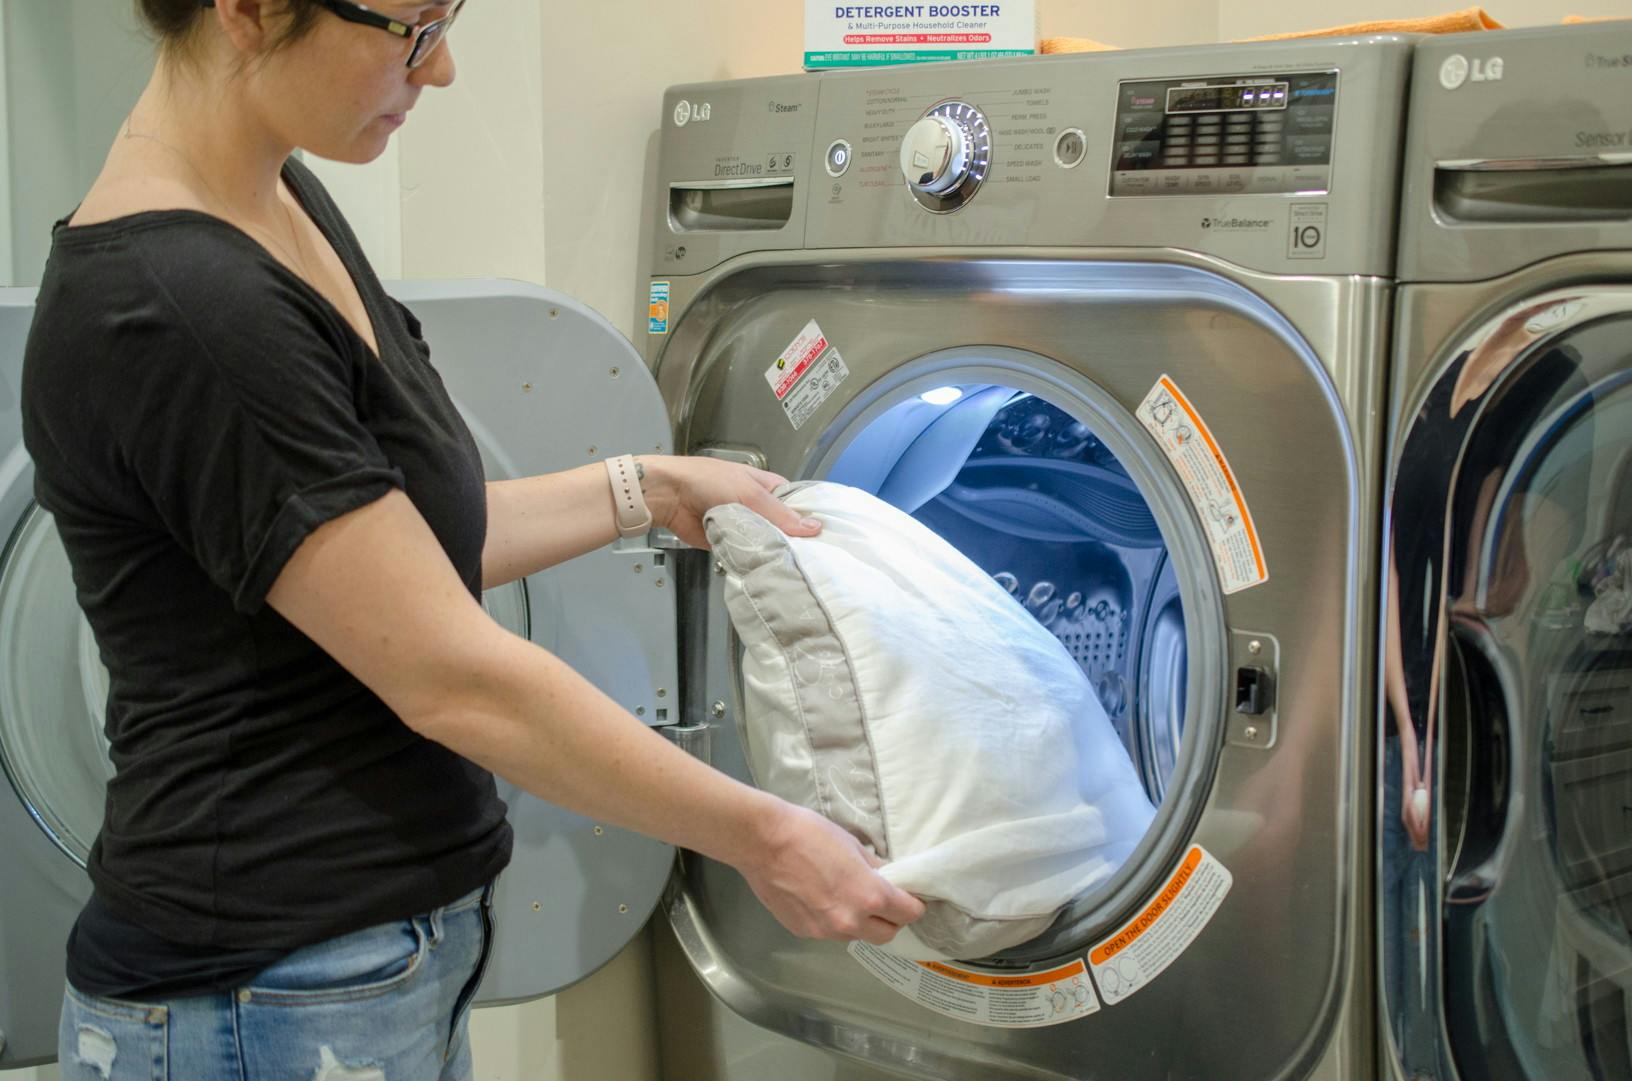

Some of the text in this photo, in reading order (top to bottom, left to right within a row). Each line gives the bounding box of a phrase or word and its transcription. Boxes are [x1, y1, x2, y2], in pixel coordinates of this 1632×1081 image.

[835, 5, 1000, 19] DETERGENT BOOSTER
[855, 22, 911, 31] Multi-Purpose
[912, 21, 955, 29] Household
[956, 21, 987, 29] Cleaner
[844, 36, 865, 44] Helps
[895, 35, 918, 43] Stains
[927, 34, 967, 43] Neutralizes
[968, 34, 991, 42] Odors
[1470, 57, 1504, 82] LG
[691, 102, 711, 121] LG
[1575, 131, 1626, 148] Sensor
[1293, 225, 1322, 249] 10
[1103, 863, 1193, 956] OPEN THE DOOR SLIGHTLY
